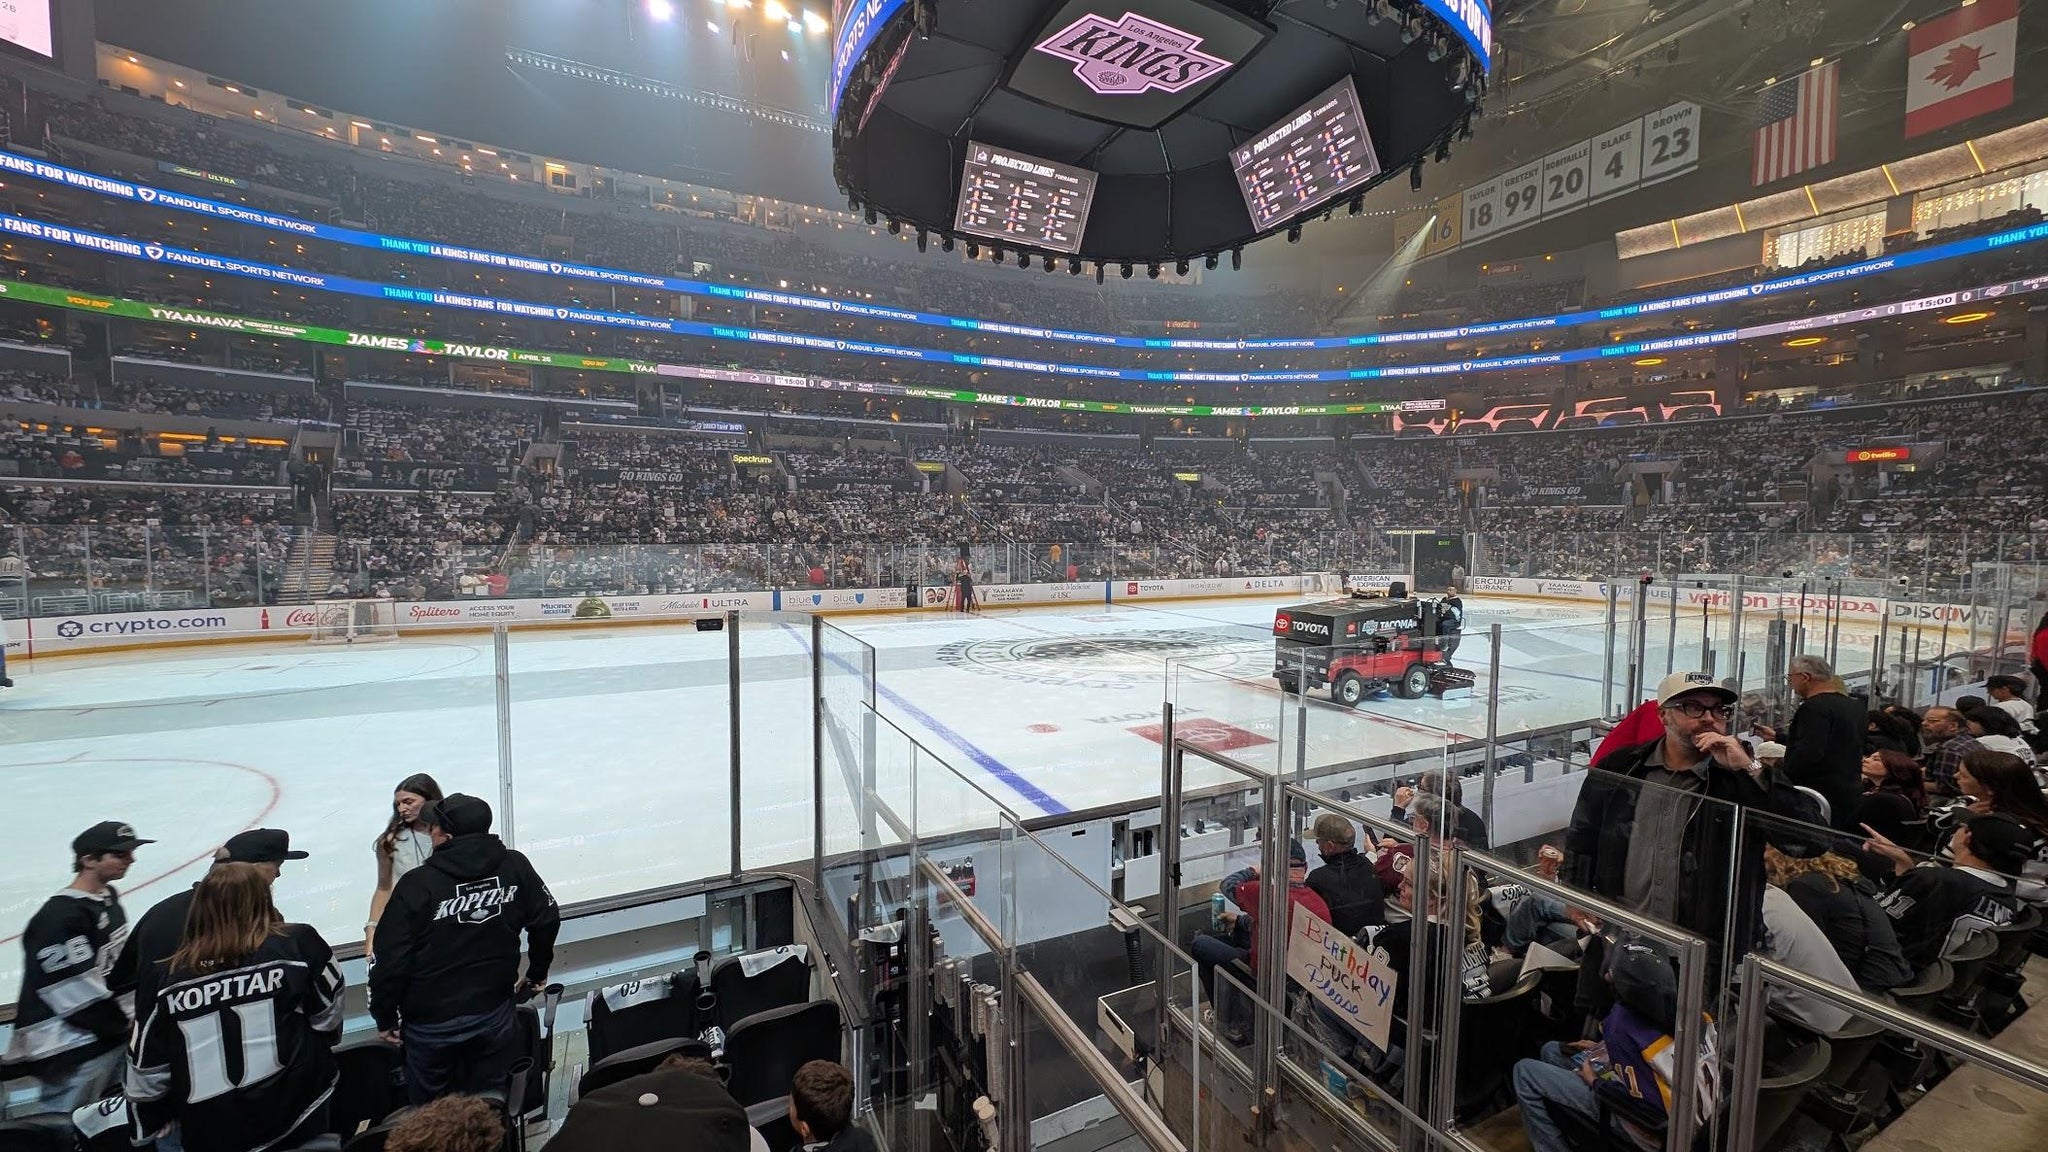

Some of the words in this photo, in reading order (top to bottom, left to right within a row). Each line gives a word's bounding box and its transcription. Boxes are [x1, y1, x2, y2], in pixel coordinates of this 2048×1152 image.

[1127, 24, 1144, 36] Los
[1146, 27, 1184, 49] Angeles
[1060, 25, 1210, 83] KINGS
[1253, 125, 1292, 156] PROJECTED
[1291, 110, 1313, 132] LINES
[1313, 98, 1338, 118] FORWARDS
[1652, 107, 1692, 130] BROWN
[1600, 130, 1632, 151] BLAKE
[1650, 127, 1691, 166] 23
[990, 154, 1035, 174] PROJECTED
[1032, 163, 1056, 178] LINES
[1545, 147, 1589, 172] ROBITAILLE
[1604, 151, 1623, 179] 4
[208, 173, 236, 185] ULTRA
[1503, 167, 1539, 188] GRETZKY
[1547, 167, 1584, 202] 20
[0, 155, 34, 172] FANS
[36, 164, 62, 179] FOR
[66, 173, 133, 196] WATCHING
[159, 195, 215, 212] FANDUEL
[218, 207, 261, 221] SPORTS
[264, 217, 315, 232] NETWORK
[1468, 185, 1496, 201] TAYLOR
[1504, 184, 1538, 216] 99
[1469, 202, 1493, 230] 18
[1431, 217, 1453, 243] 16
[1988, 231, 2025, 245] THANK
[5, 219, 41, 235] FANS
[44, 226, 70, 241] FOR
[73, 234, 141, 254] WATCHING
[167, 253, 224, 268] FANDUEL
[226, 263, 270, 276] SPORTS
[272, 271, 324, 285] NETWORK
[382, 238, 410, 250] THANK
[413, 243, 429, 253] YOU
[430, 246, 441, 255] LA
[443, 248, 468, 259] KINGS
[470, 252, 489, 262] FANS
[491, 255, 506, 265] FOR
[508, 257, 548, 271] WATCHING
[564, 266, 599, 277] FANDUEL
[600, 272, 628, 281] SPORTS
[630, 276, 664, 285] NETWORK
[1600, 309, 1622, 317] THANK
[1624, 306, 1638, 314] YOU
[1648, 301, 1670, 310] KINGS
[1672, 298, 1690, 306] FANS
[1692, 295, 1706, 304] FOR
[1708, 288, 1748, 301] WATCHING
[1766, 279, 1807, 289] FANDUEL
[1808, 270, 1844, 282] SPORTS
[1846, 261, 1894, 274] NETWORK
[1962, 292, 1971, 302] 0
[384, 287, 413, 299] THANK
[416, 291, 432, 301] YOU
[434, 294, 444, 303] LA
[446, 296, 472, 306] KINGS
[474, 299, 494, 309] FANS
[497, 302, 512, 311] FOR
[514, 305, 554, 316] WATCHING
[570, 312, 606, 321] FANDUEL
[607, 315, 635, 325] SPORTS
[636, 319, 671, 328] NETWORK
[710, 286, 730, 295] THANK
[732, 289, 744, 297] YOU
[753, 292, 771, 301] KINGS
[772, 294, 787, 303] FANS
[789, 296, 800, 305] FOR
[802, 298, 830, 309] WATCHING
[842, 303, 868, 313] FANDUEL
[870, 307, 890, 316] SPORTS
[890, 312, 916, 320] NETWORK
[1887, 305, 1895, 314] 0
[1917, 296, 1952, 309] 15:00
[346, 333, 408, 350] JAMES
[444, 343, 508, 361] TAYLOR
[518, 354, 542, 362] APRIL
[1602, 347, 1623, 355] THANK
[1650, 340, 1672, 349] KINGS
[1674, 338, 1692, 346] FANS
[1694, 336, 1708, 344] FOR
[784, 377, 805, 386] 15:00
[975, 394, 1007, 404] JAMES
[1025, 397, 1061, 408] TAYLOR
[1210, 406, 1242, 415] JAMES
[1261, 406, 1299, 415] TAYLOR
[1950, 399, 1980, 410] CLUB
[733, 454, 769, 466] Spectrum
[1871, 449, 1897, 459] twilio
[619, 471, 634, 481] GO
[635, 471, 667, 482] KINGS
[668, 472, 684, 483] GO
[1538, 487, 1566, 495] KINGS
[1567, 486, 1581, 494] GO
[1255, 580, 1285, 588] DELTA
[1474, 577, 1513, 586] ERCURY
[660, 600, 700, 611] Michelob
[712, 598, 748, 607] ULTRA
[788, 595, 811, 604] blue
[833, 594, 854, 603] blue
[1776, 597, 1877, 613] HONDA
[89, 613, 226, 634] crypto.com
[410, 605, 460, 622] Splitero
[1292, 621, 1329, 635] TOYOTA
[1380, 619, 1414, 630] TACOMA
[1085, 706, 1204, 724] TOYOTA
[433, 885, 518, 920] KOPITAR
[37, 935, 94, 974] 26
[1300, 916, 1391, 1006] Birthday
[1320, 955, 1363, 1001] PUCK
[167, 968, 284, 1014] KOPITAR
[1304, 962, 1373, 1027] Please
[176, 999, 285, 1104] 11
